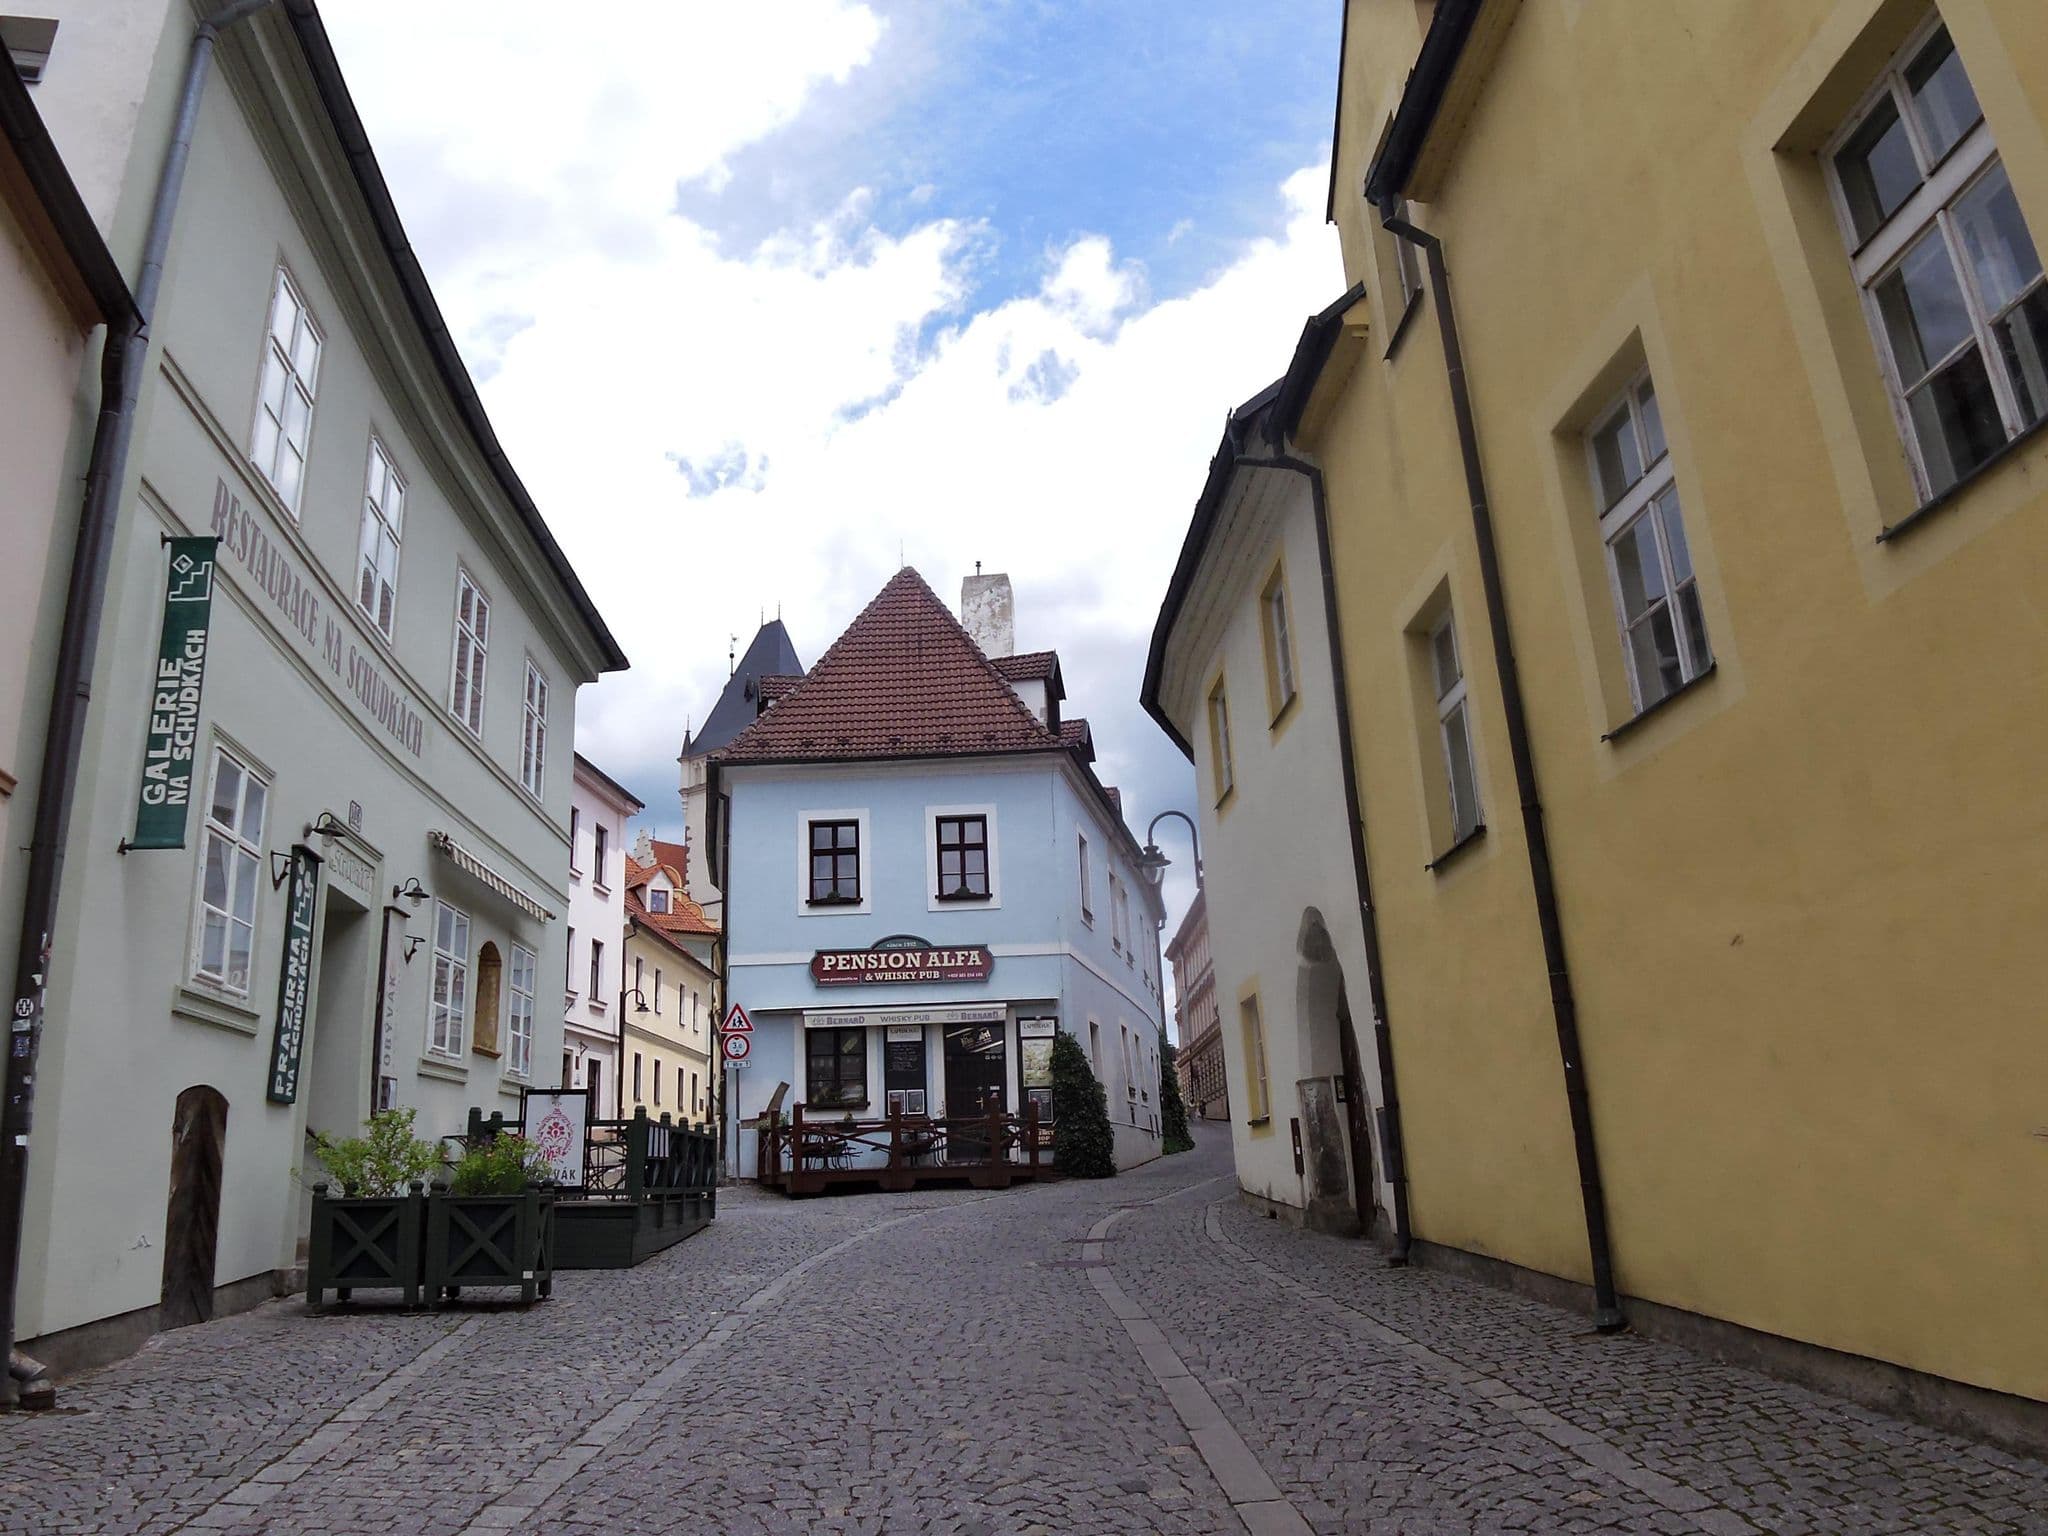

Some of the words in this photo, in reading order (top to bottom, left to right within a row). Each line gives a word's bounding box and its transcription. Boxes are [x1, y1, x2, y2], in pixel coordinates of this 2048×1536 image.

[211, 476, 319, 647] RESTAURACE
[322, 614, 342, 677] NA
[143, 657, 182, 805] GALERIE
[167, 775, 190, 805] NA
[822, 952, 922, 971] PENSION
[927, 950, 983, 967] ALFA
[865, 972, 873, 981] &
[874, 971, 917, 981] WHISKY
[919, 970, 940, 979] PUB
[879, 1014, 912, 1023] WHISKY
[913, 1013, 930, 1022] PUB
[285, 1069, 296, 1096] NA
